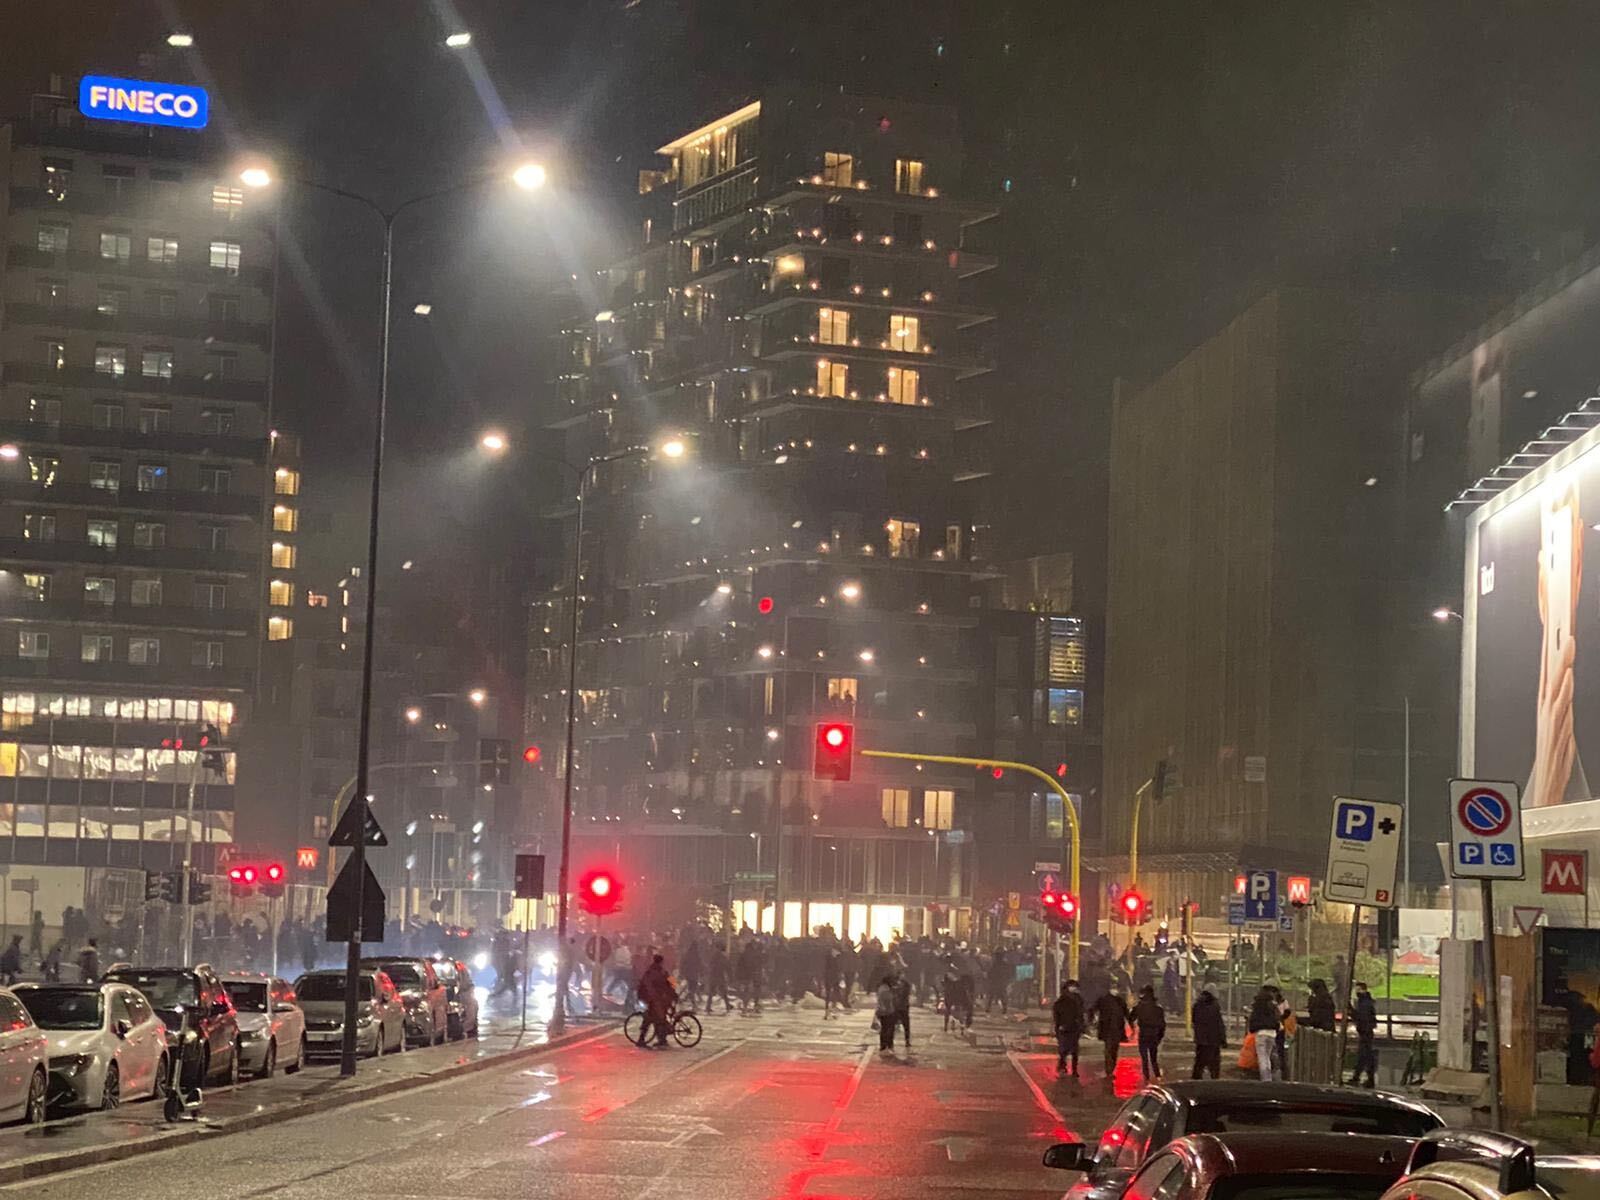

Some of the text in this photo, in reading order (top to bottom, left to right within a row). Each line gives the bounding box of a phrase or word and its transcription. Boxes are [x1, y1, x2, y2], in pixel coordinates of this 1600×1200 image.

[90, 86, 198, 118] FINECO
[1345, 809, 1367, 834] P
[298, 854, 316, 867] M
[1464, 845, 1479, 862] P
[1546, 861, 1579, 885] M
[1251, 873, 1270, 900] P
[1290, 883, 1307, 900] M
